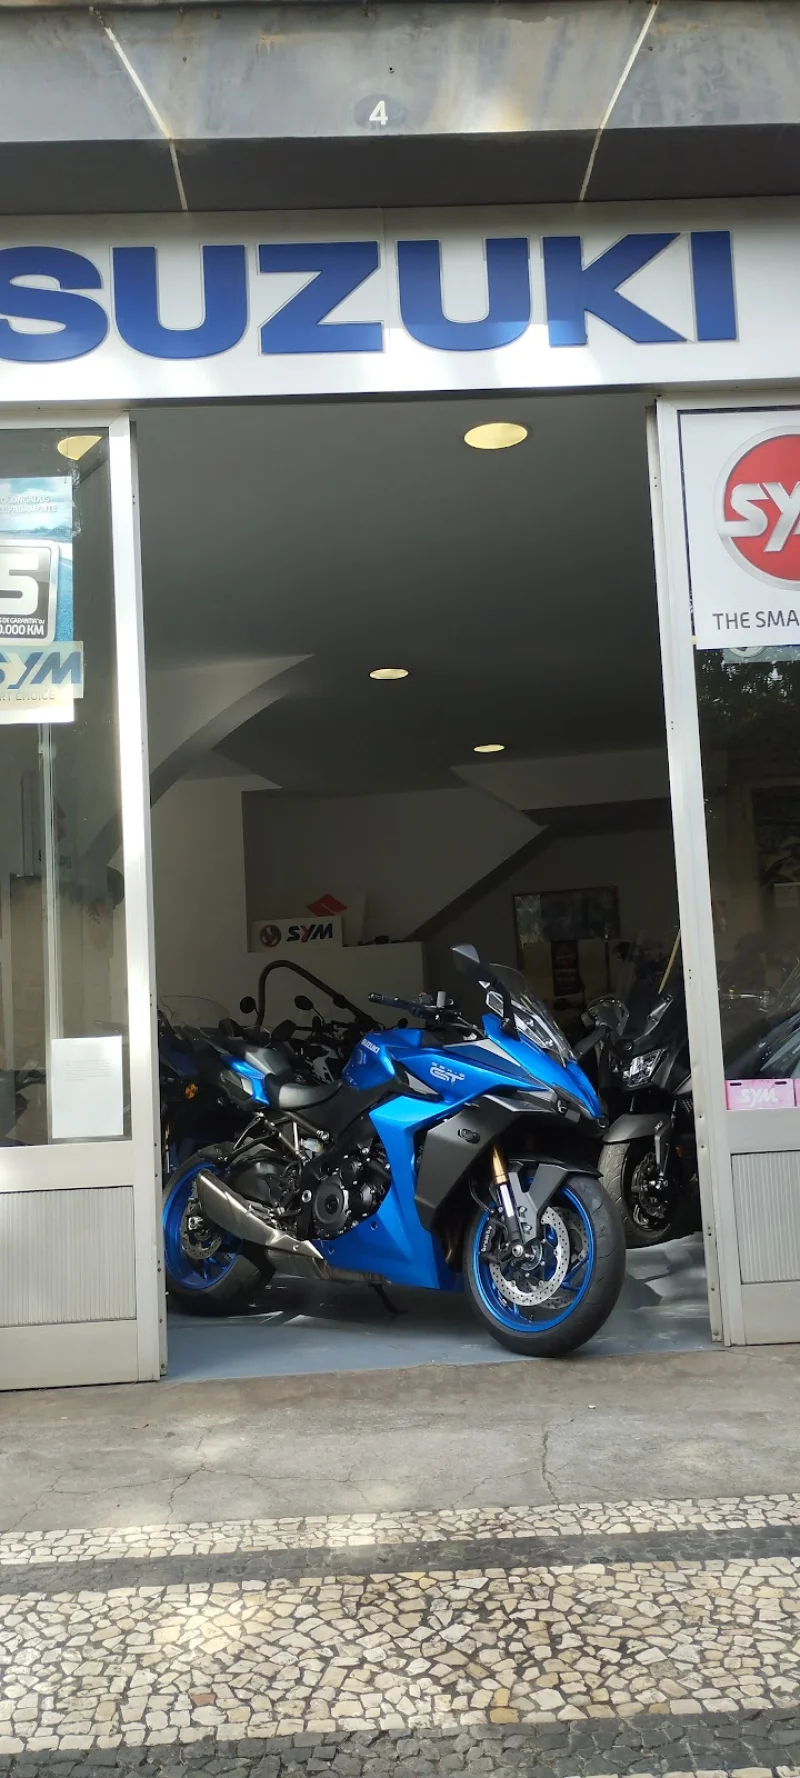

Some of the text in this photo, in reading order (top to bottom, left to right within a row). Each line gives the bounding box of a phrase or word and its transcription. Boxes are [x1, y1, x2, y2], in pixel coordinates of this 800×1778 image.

[369, 100, 389, 125] 4
[0, 230, 739, 363] SUZUKI
[722, 480, 800, 553] SY
[27, 624, 45, 636] KM
[712, 609, 800, 630] THE SMA
[286, 923, 333, 943] SYM
[740, 1086, 779, 1107] SYM
